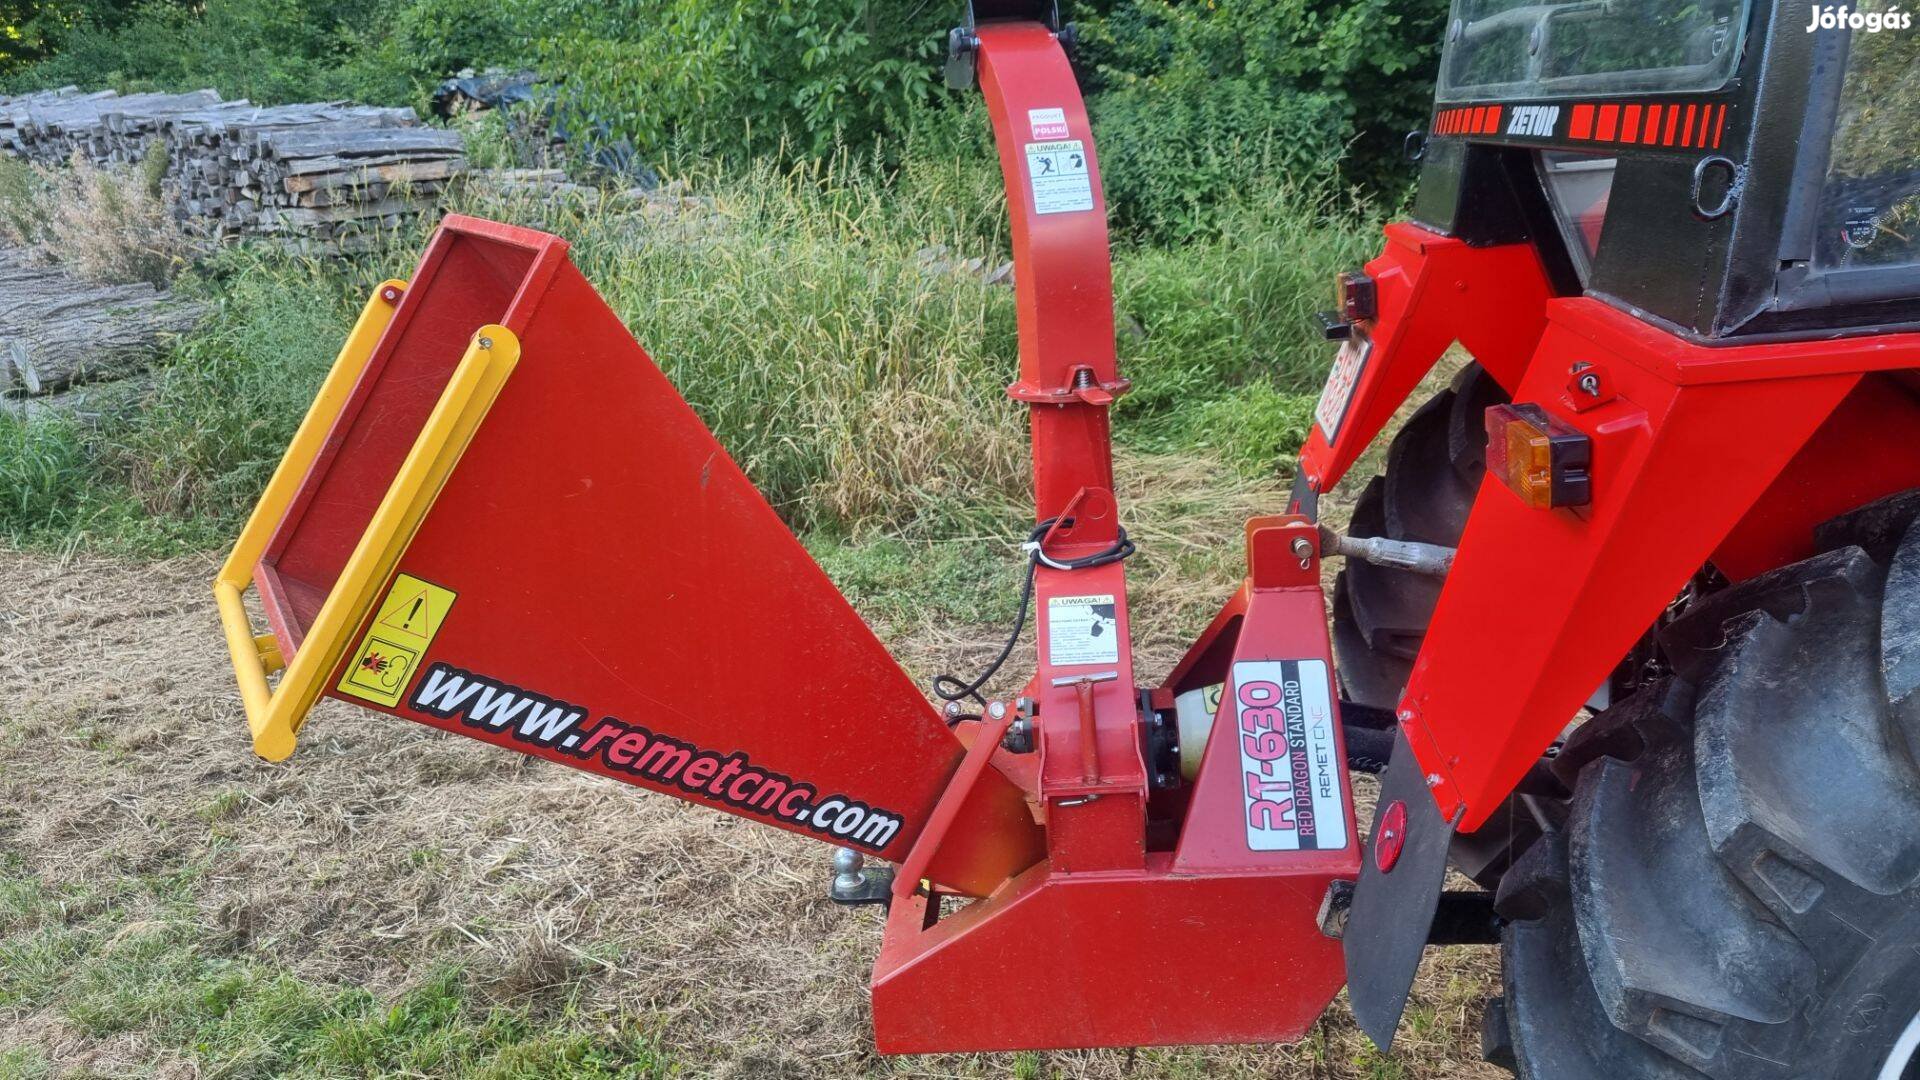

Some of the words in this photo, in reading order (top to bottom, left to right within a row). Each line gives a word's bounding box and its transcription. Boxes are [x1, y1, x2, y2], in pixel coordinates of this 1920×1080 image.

[1034, 125, 1066, 135] POLSKI
[1506, 105, 1560, 137] ZETOR
[1036, 143, 1072, 152] UWAGA!
[1061, 597, 1101, 605] UWAGA!
[1283, 680, 1305, 748] STANDARD
[416, 669, 900, 847] www.remetcnc.com
[1238, 680, 1296, 831] RT-630
[1315, 742, 1332, 799] REMET
[1290, 751, 1312, 807] DRAGON
[1299, 815, 1316, 836] RED
